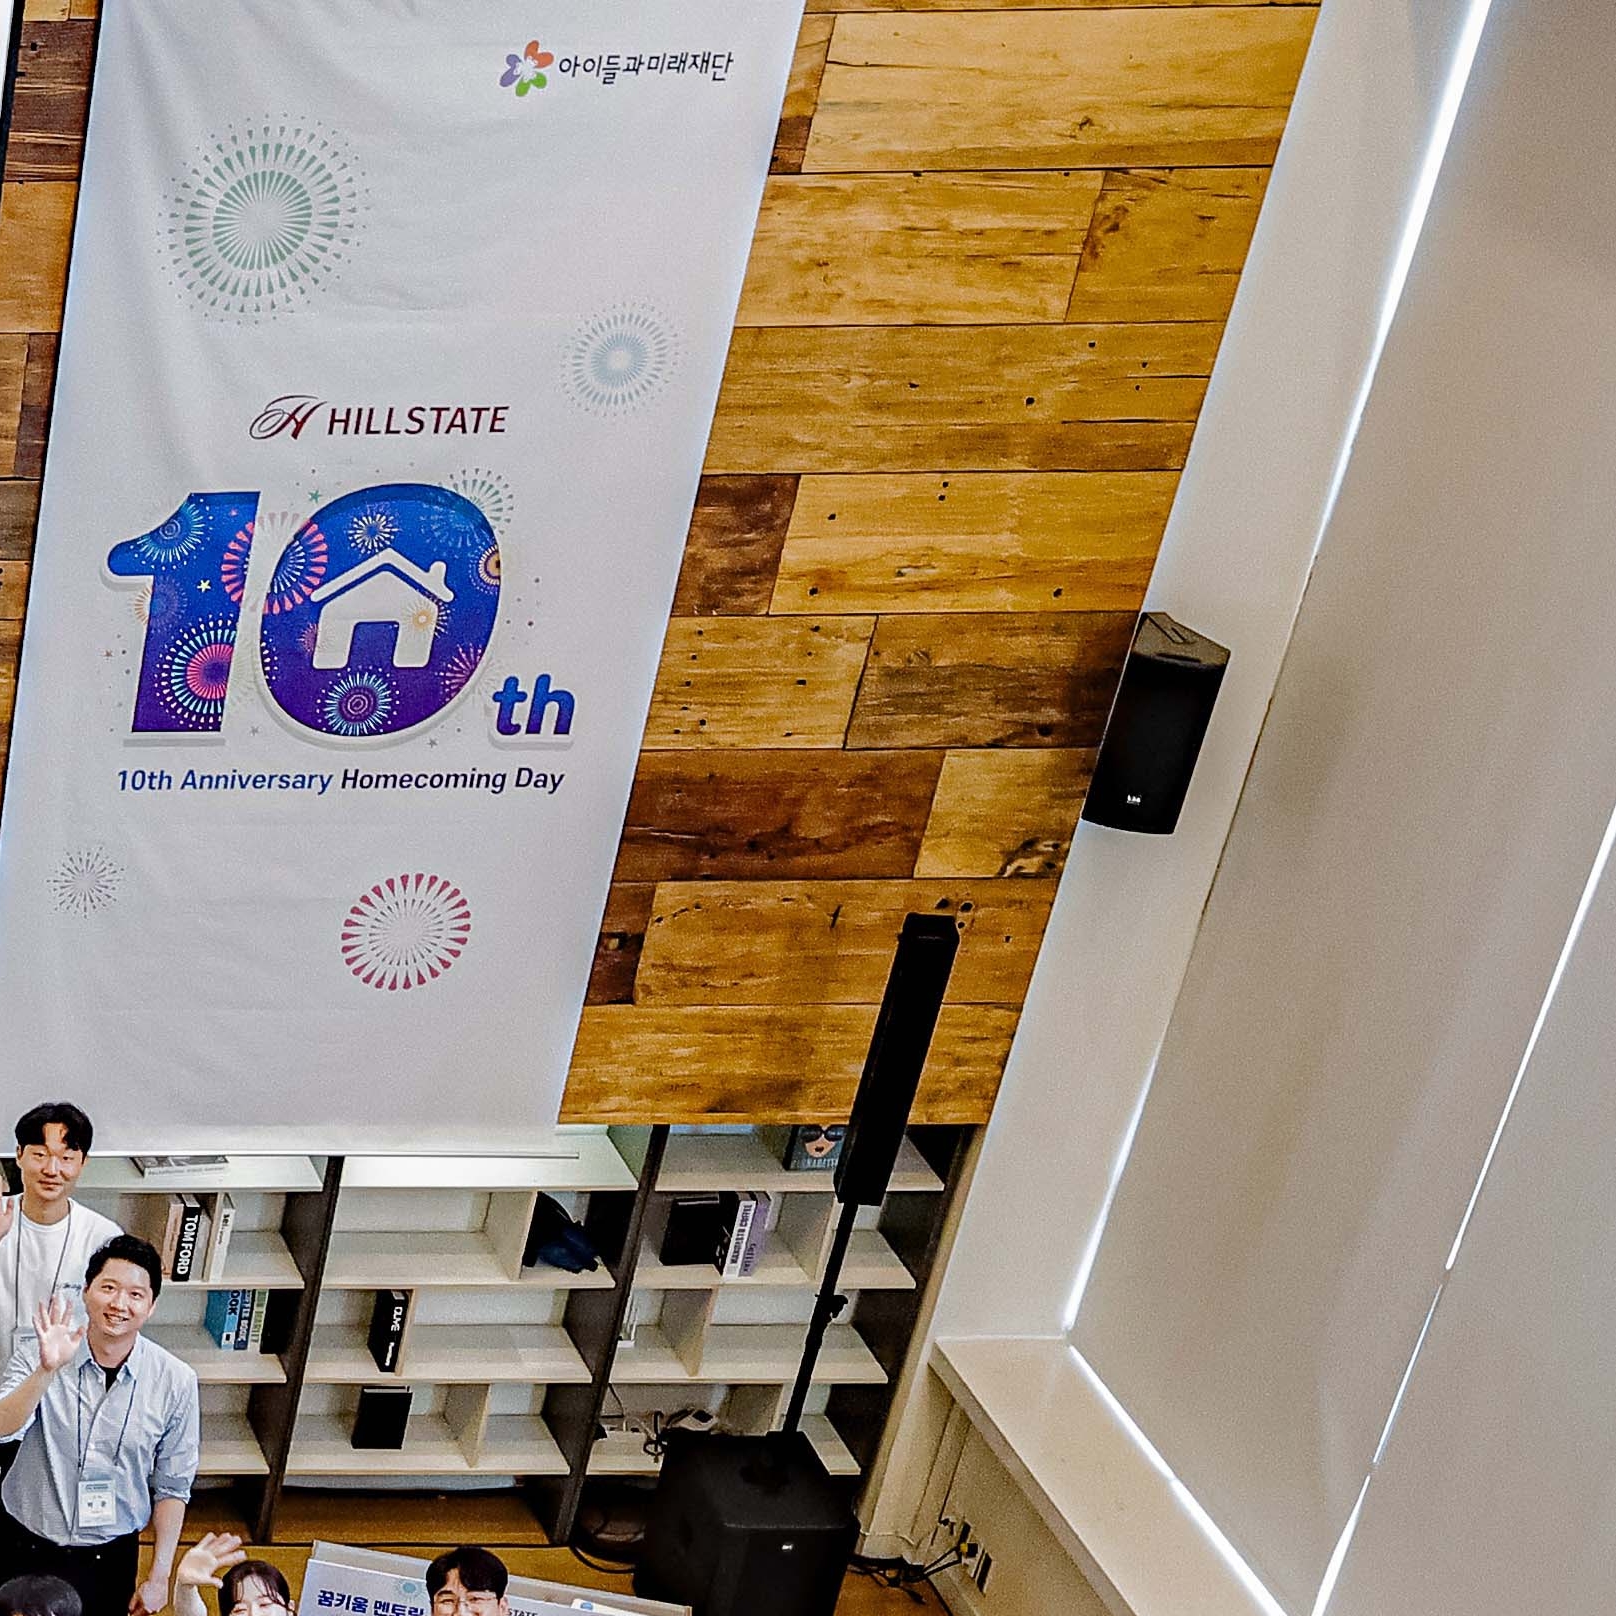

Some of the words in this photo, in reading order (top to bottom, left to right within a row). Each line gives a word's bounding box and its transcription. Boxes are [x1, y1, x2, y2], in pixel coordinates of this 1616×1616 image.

[558, 48, 734, 88] 아이들과미래재단
[327, 404, 510, 439] HILLSTATE
[116, 768, 173, 793] 10th
[180, 767, 333, 798] Anniversary
[339, 767, 508, 799] Homecoming
[513, 768, 566, 797] Day
[184, 1215, 198, 1242] TOM
[177, 1243, 194, 1275] FORD
[317, 1590, 369, 1614] 꿈키움
